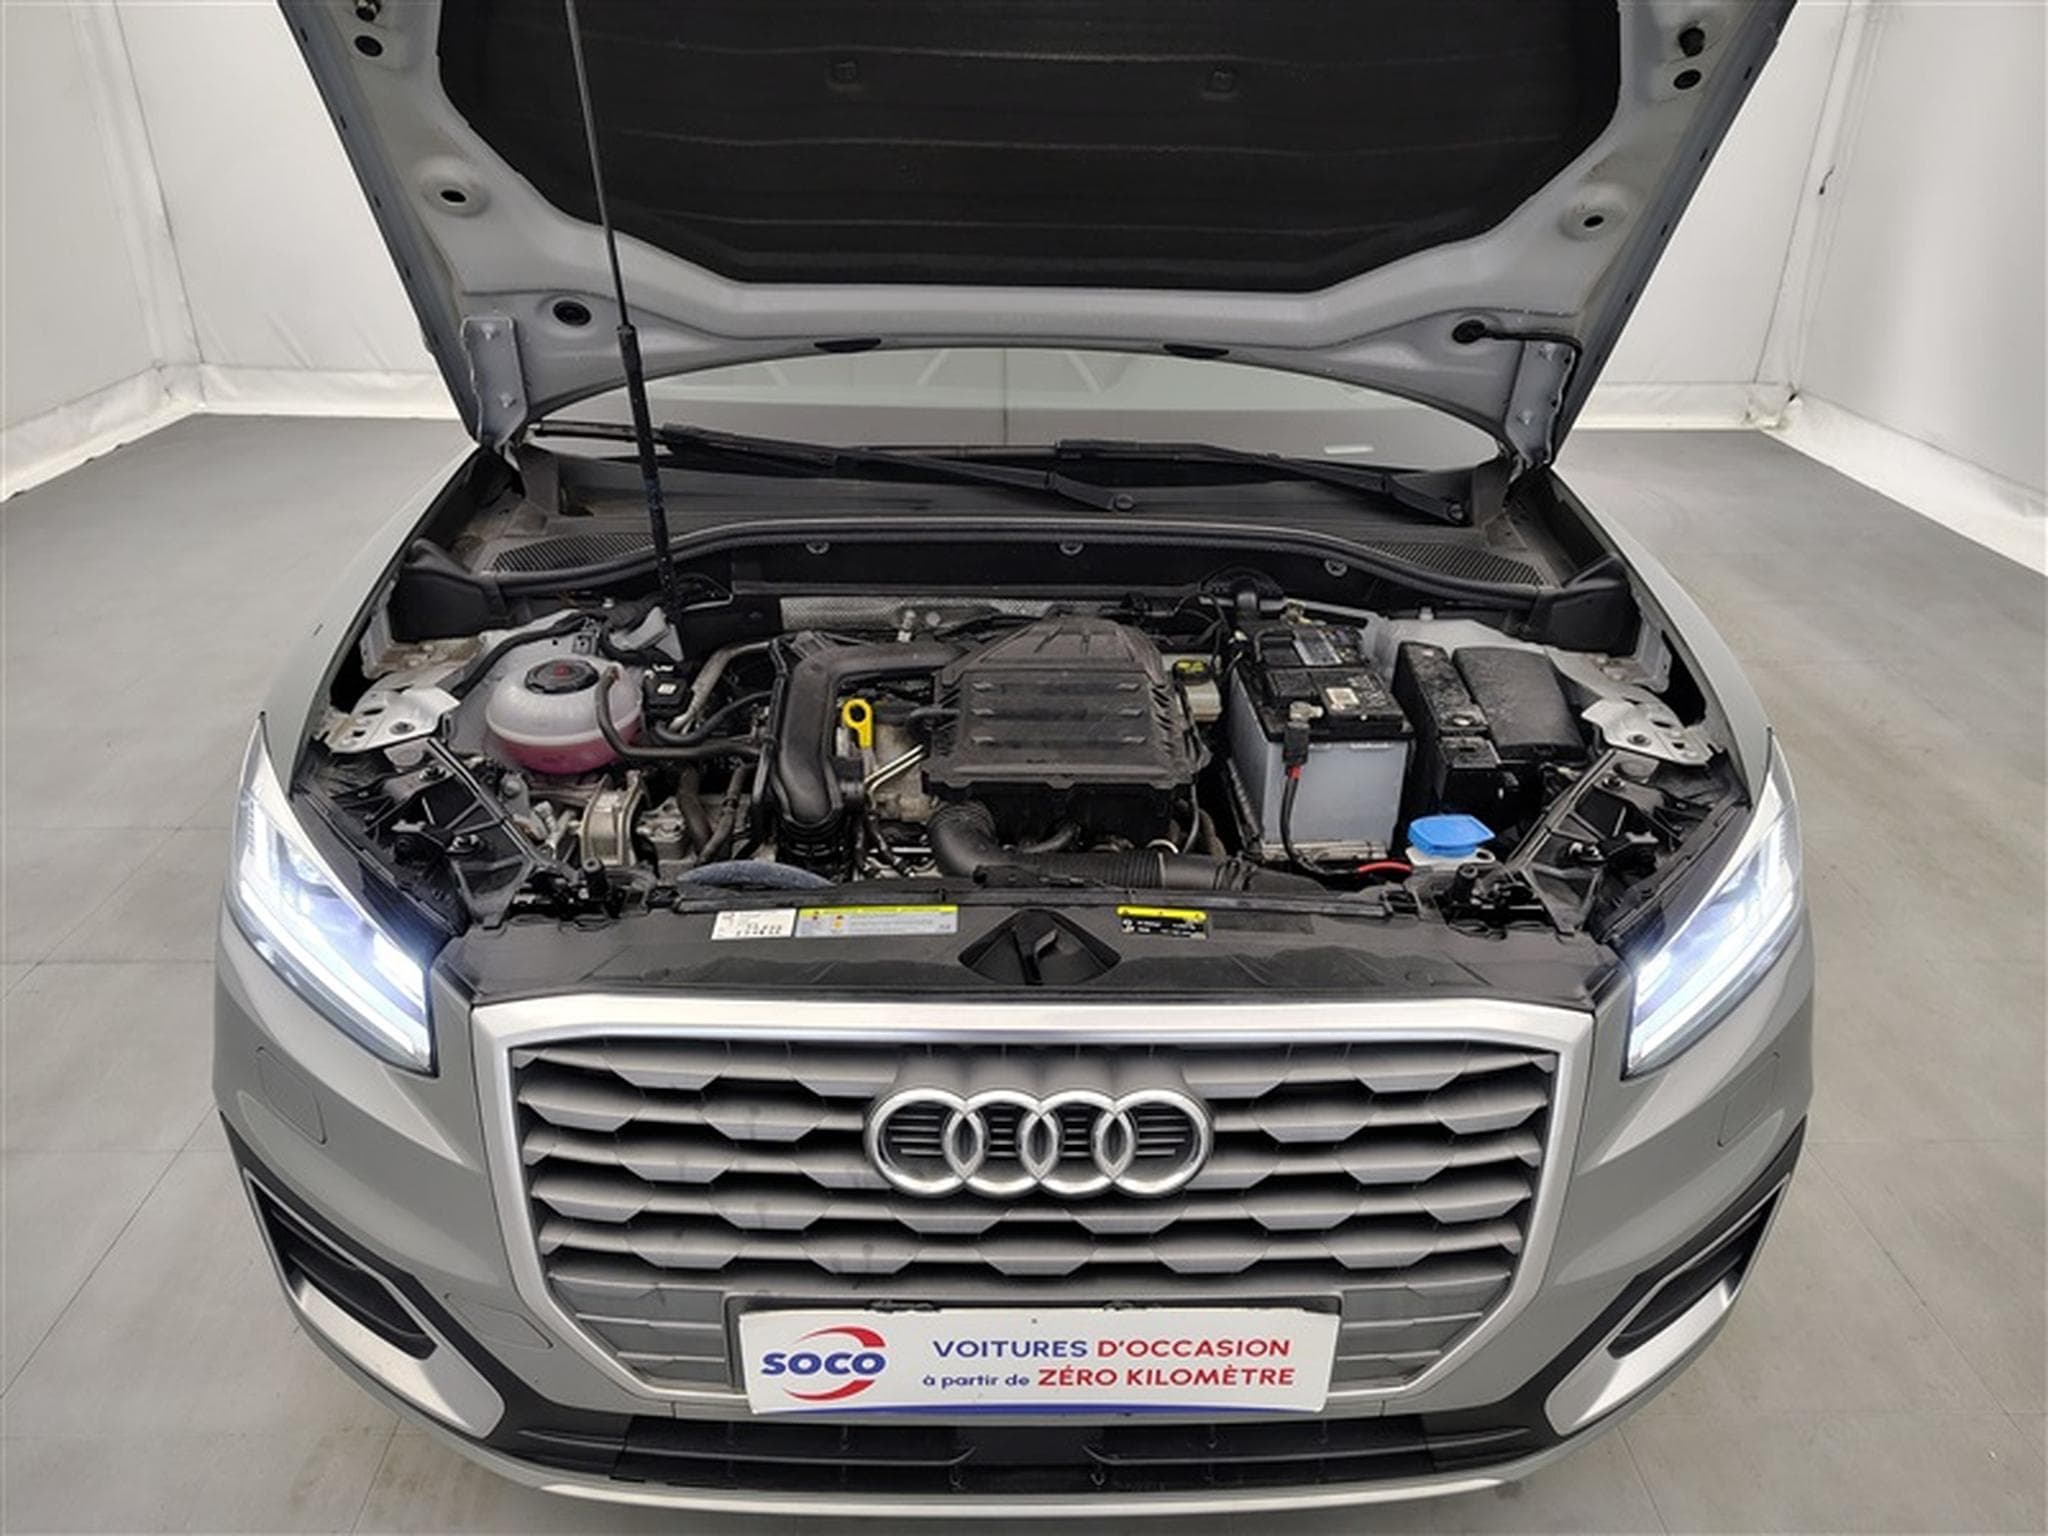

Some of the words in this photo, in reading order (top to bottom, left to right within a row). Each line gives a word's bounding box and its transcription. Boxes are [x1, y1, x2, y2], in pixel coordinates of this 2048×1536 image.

[933, 1340, 1088, 1359] VOITURES
[1098, 1340, 1290, 1358] D'OCCASION
[761, 1352, 886, 1376] SOCO
[923, 1373, 935, 1388] à
[941, 1372, 999, 1390] partir
[1004, 1372, 1030, 1388] de
[1038, 1365, 1117, 1386] ZÉRO
[1126, 1364, 1294, 1386] KILOMÈTRE
